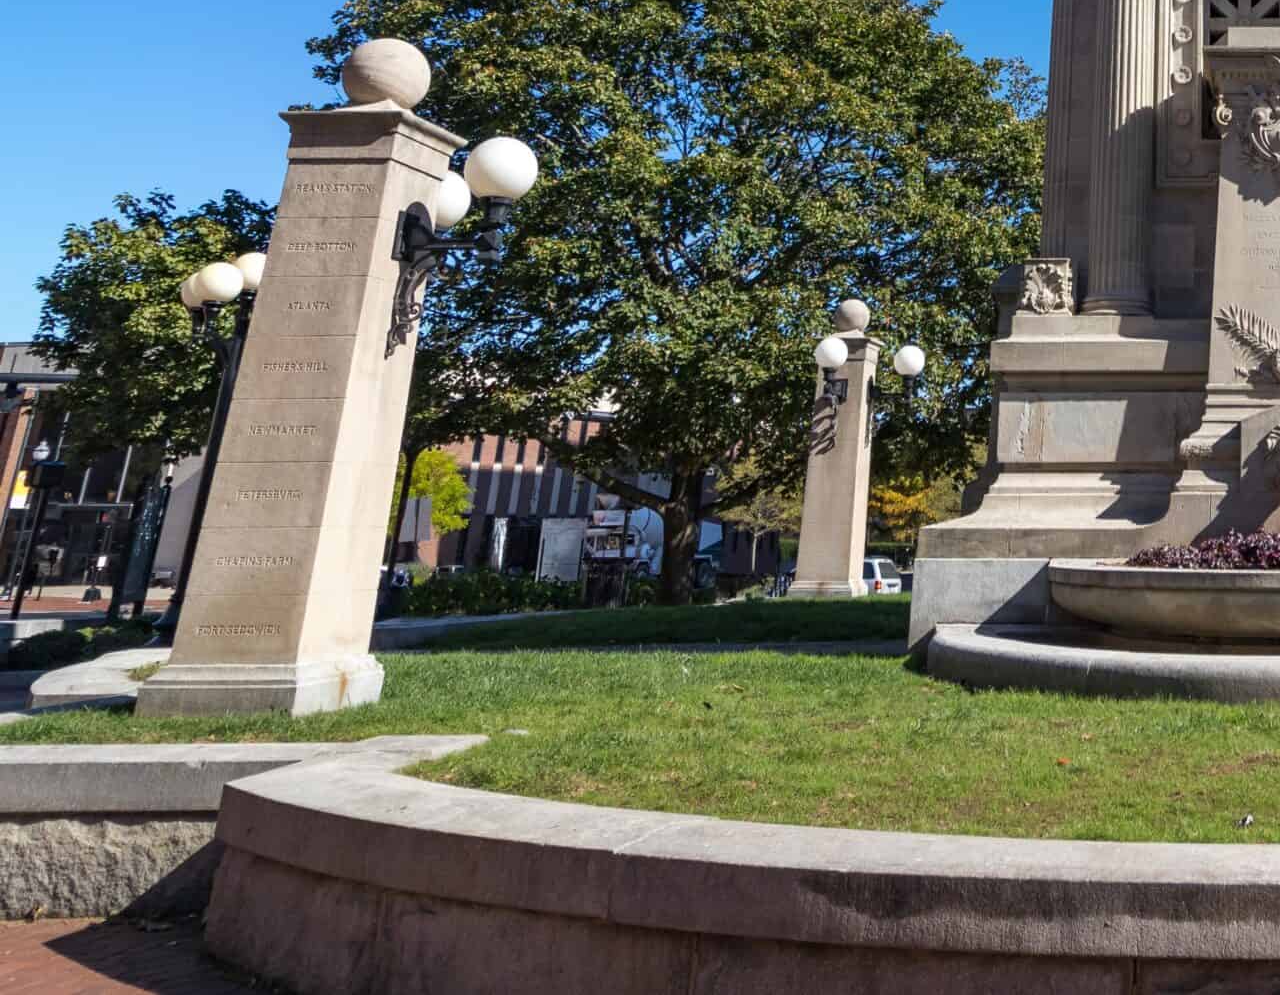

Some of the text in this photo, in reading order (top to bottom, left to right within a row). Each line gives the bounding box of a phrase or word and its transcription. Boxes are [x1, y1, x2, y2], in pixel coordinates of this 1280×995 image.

[287, 242, 355, 253] DEEP BOTTOM
[287, 300, 330, 310] ATLANTA
[305, 362, 328, 373] HILL
[264, 556, 294, 567] FARM
[198, 624, 224, 636] FORT
